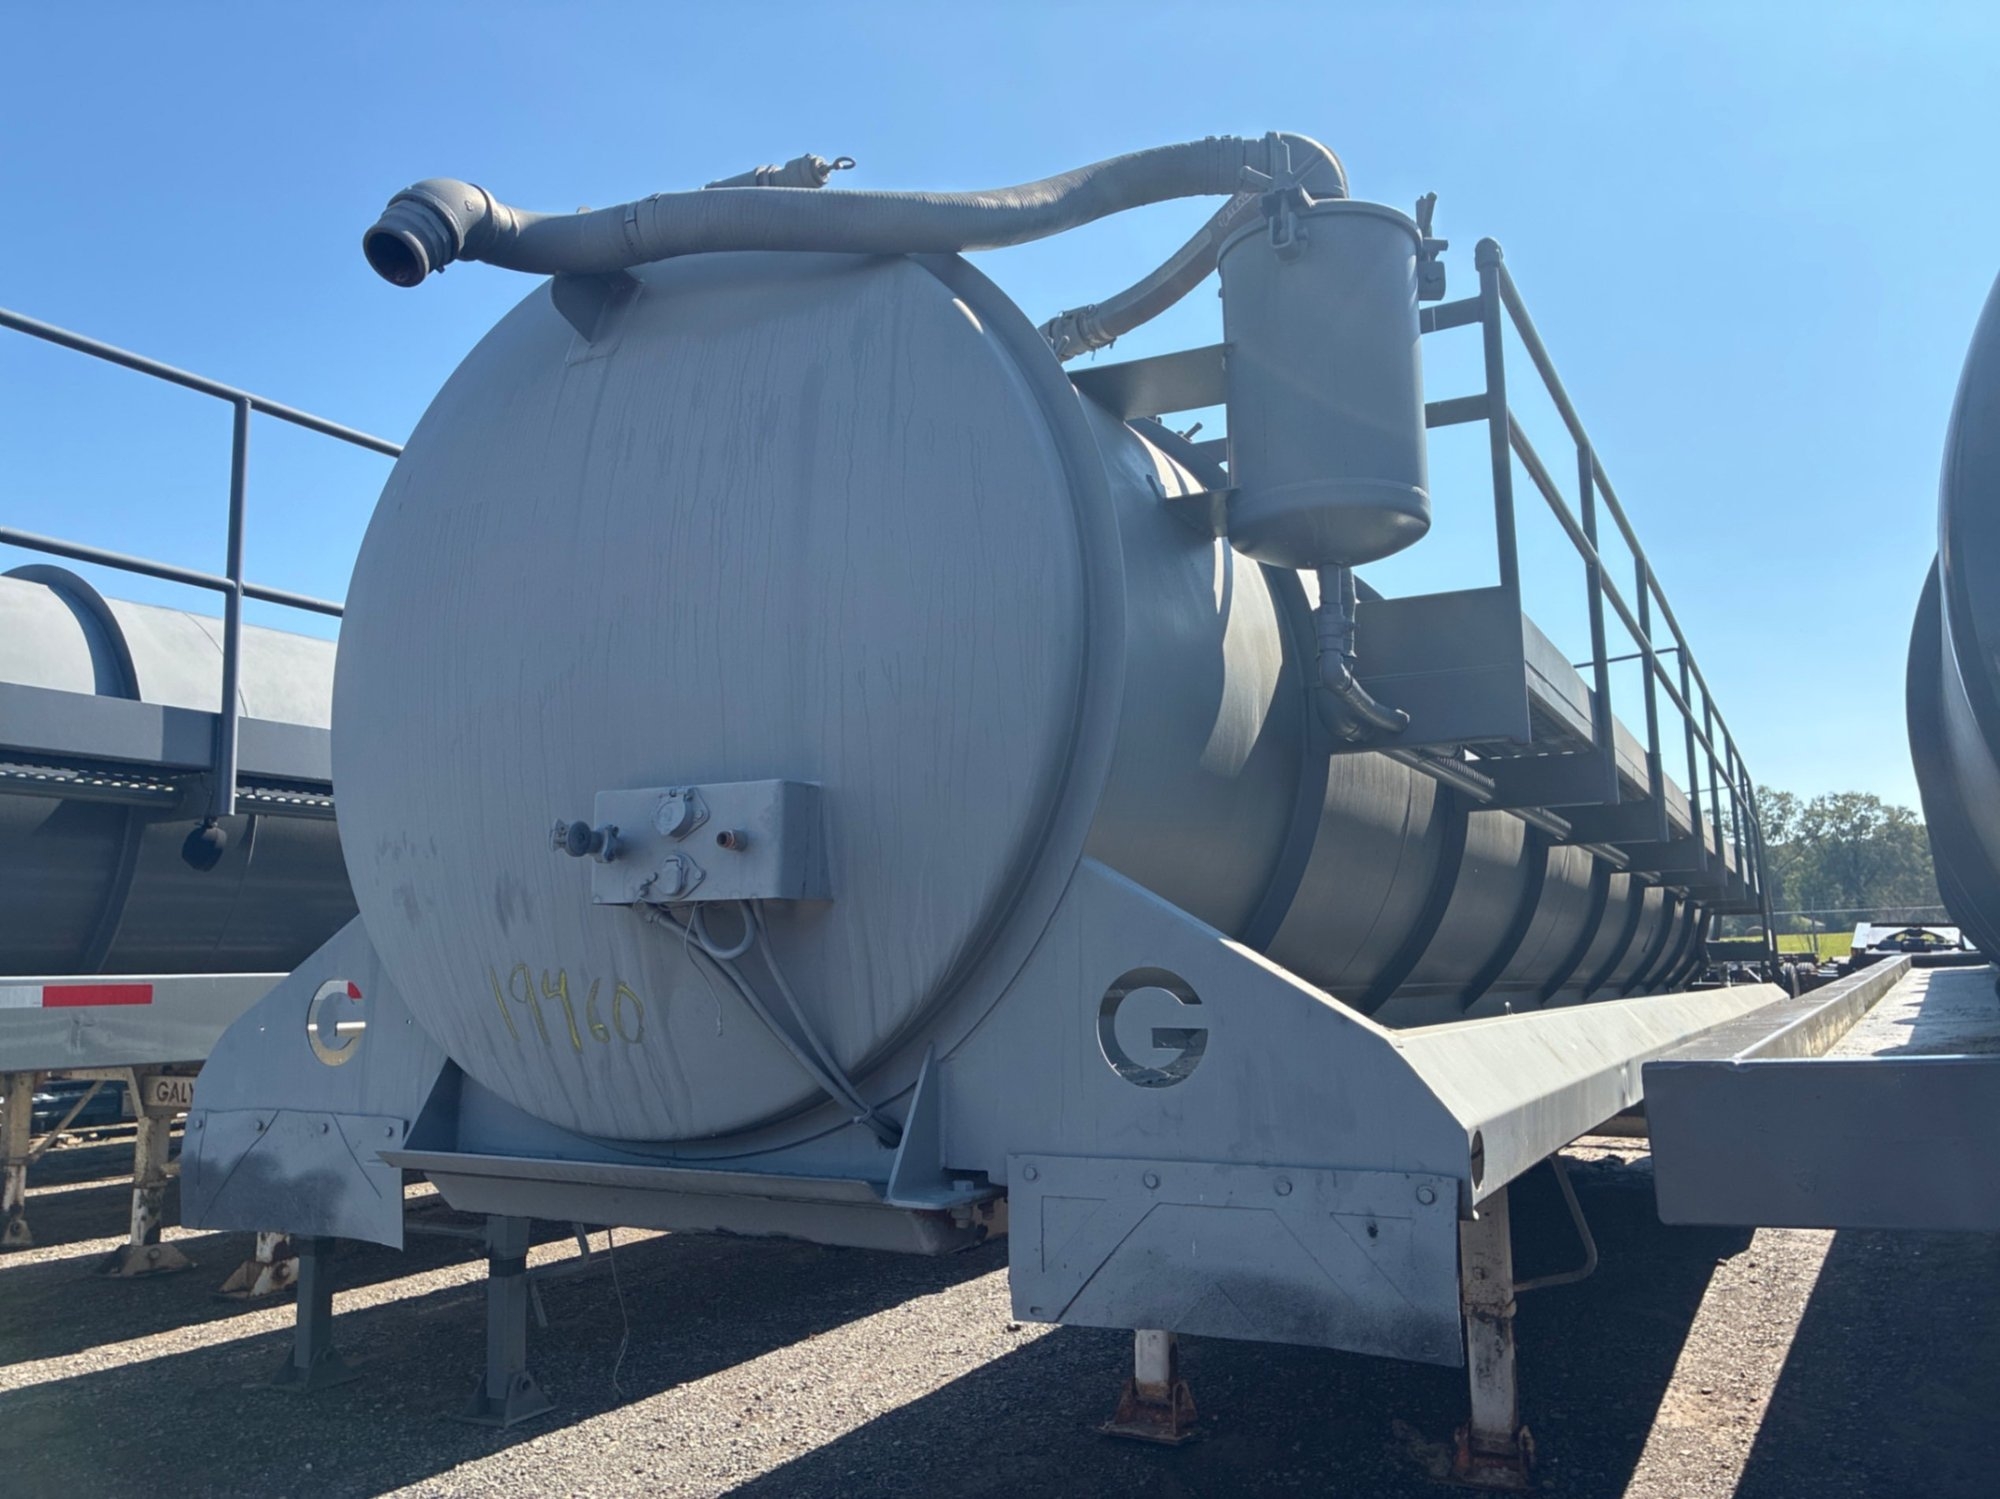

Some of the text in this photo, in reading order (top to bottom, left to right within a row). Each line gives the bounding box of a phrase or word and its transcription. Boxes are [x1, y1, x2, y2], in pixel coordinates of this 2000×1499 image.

[306, 978, 366, 1067] G
[489, 963, 645, 1054] 19460
[1096, 966, 1209, 1089] G
